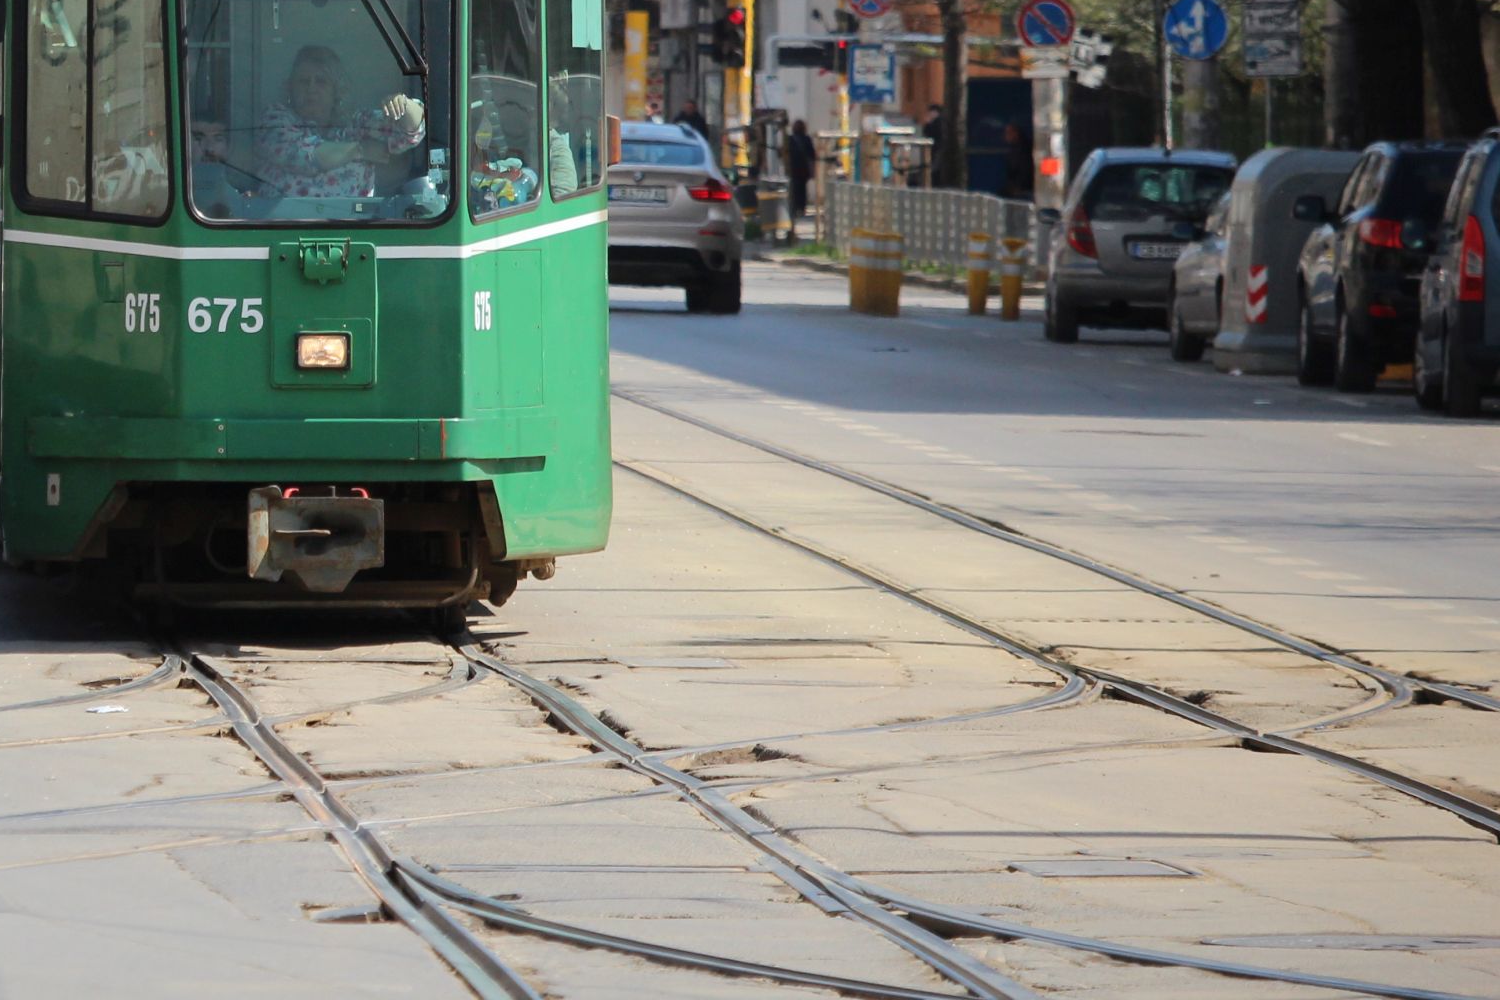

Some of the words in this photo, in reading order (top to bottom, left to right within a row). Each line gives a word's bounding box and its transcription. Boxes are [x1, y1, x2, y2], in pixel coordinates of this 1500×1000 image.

[125, 293, 160, 333] 675
[187, 297, 264, 333] 675
[474, 291, 491, 331] 675
